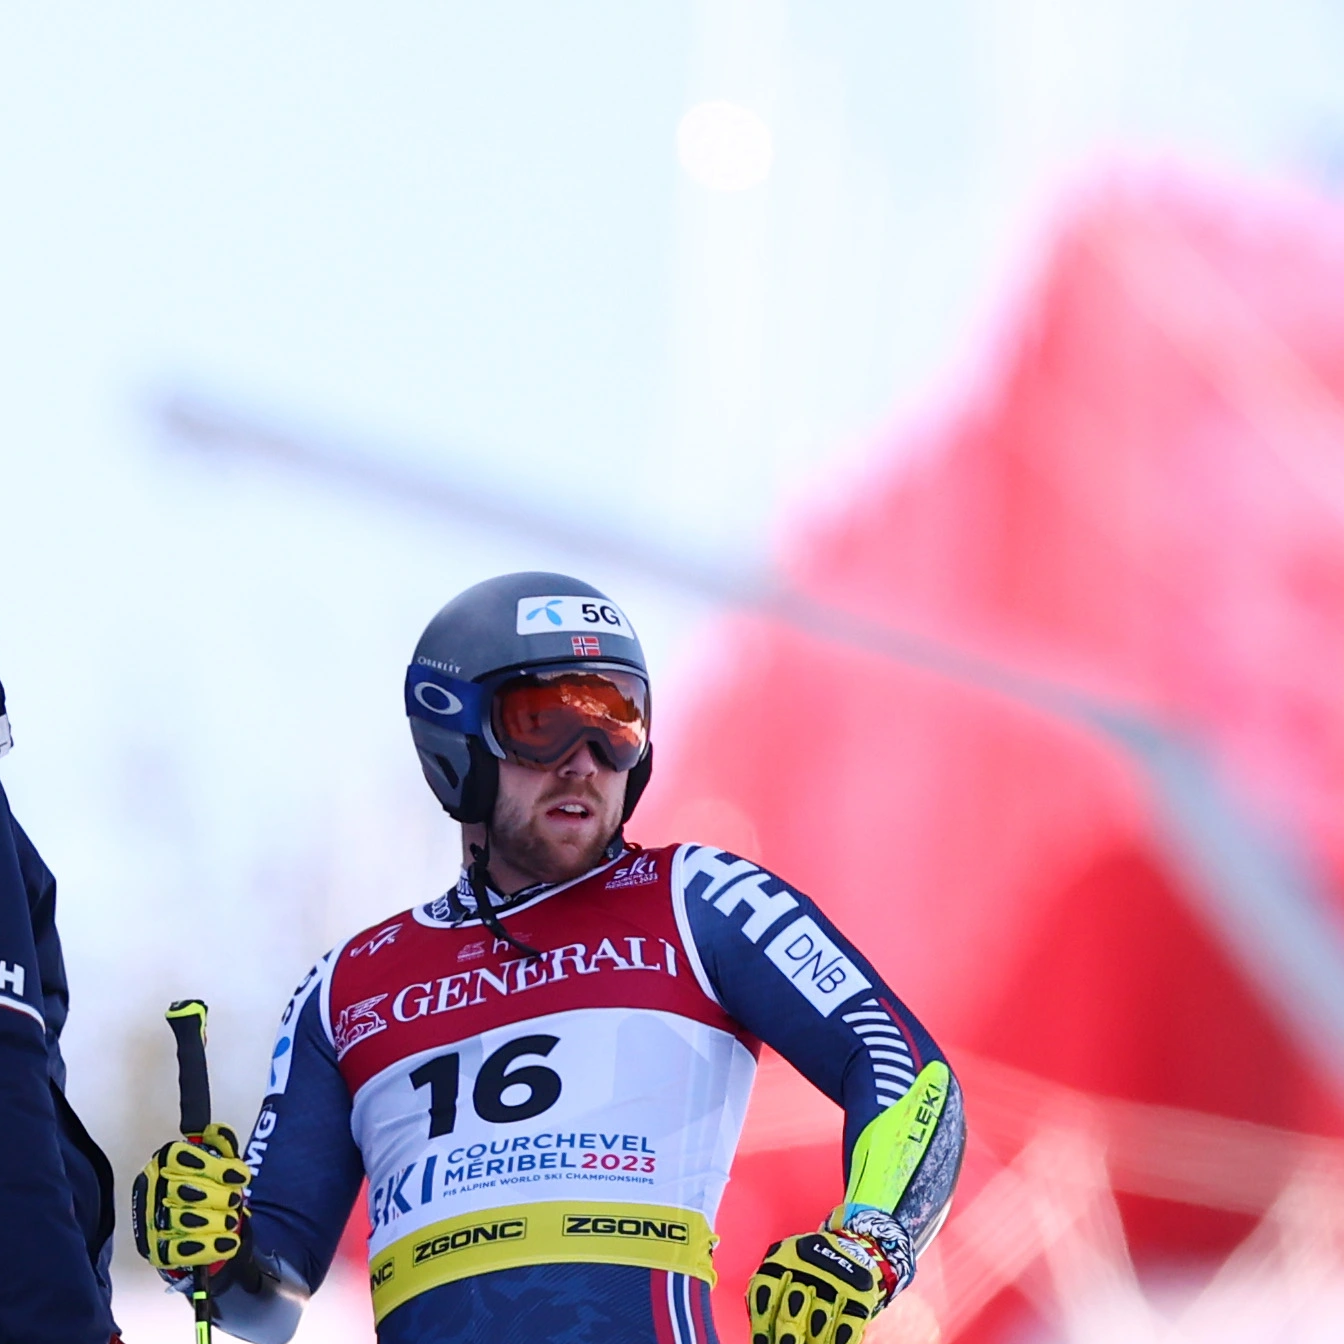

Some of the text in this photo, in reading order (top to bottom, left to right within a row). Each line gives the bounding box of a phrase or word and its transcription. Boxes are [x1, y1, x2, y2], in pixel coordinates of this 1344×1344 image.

[581, 603, 622, 628] 5G
[417, 656, 462, 674] OAKLEY
[683, 845, 800, 944] HH
[391, 937, 677, 1023] GENERALI
[784, 933, 846, 995] DNB
[409, 1034, 562, 1139] 16
[907, 1082, 942, 1144] LEKI
[447, 1133, 656, 1164] COURCHEVEL
[442, 1172, 655, 1198] FIS ALPINE WORLD SKI CHAMPIONSHIPS
[444, 1152, 656, 1186] MÉRIBEL 2023
[414, 1217, 687, 1264] ZGONC ZGONC
[812, 1242, 855, 1275] LEVEL
[369, 1261, 394, 1293] NC
